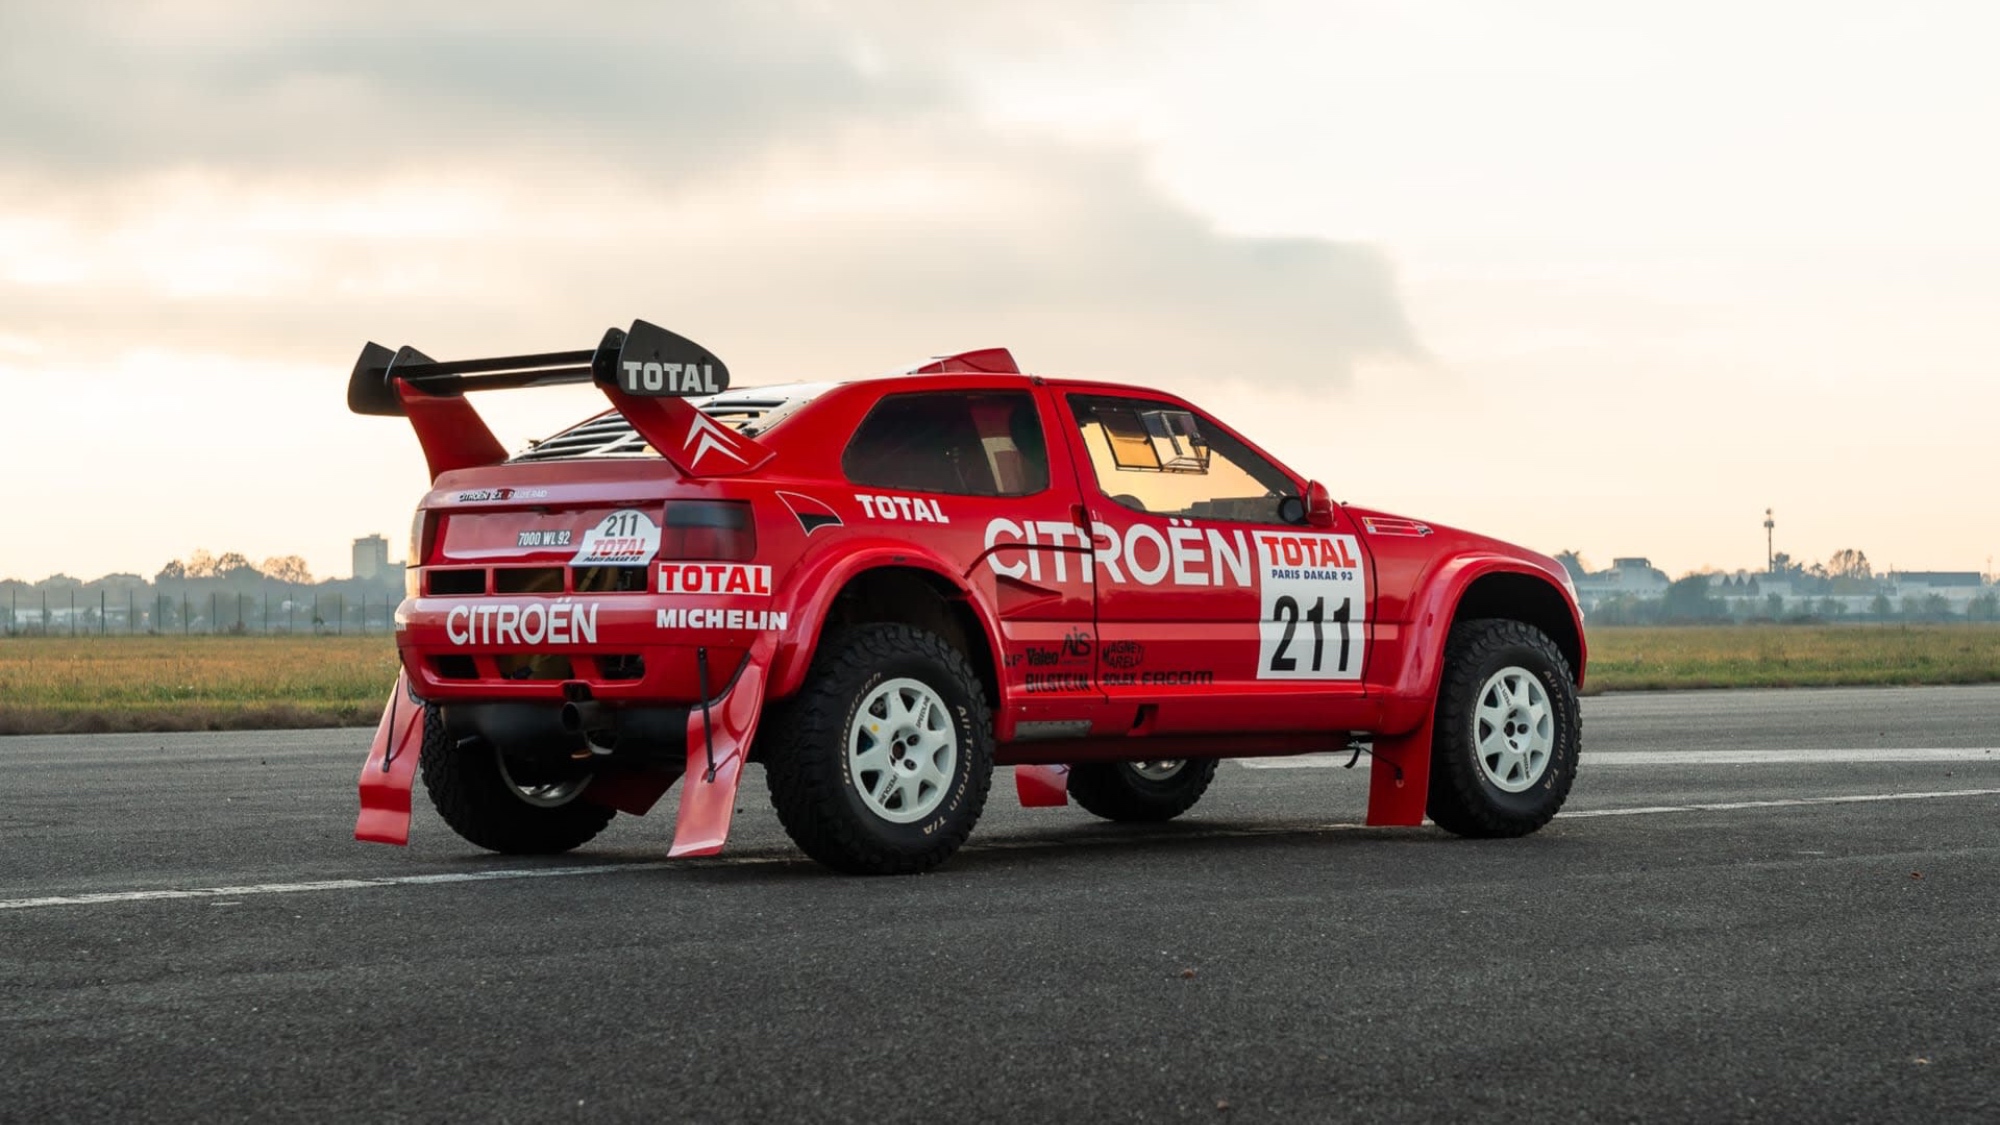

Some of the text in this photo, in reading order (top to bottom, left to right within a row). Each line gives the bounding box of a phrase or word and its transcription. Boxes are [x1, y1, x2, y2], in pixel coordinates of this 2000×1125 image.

[623, 361, 719, 393] TOTAL
[854, 494, 950, 523] TOTAL
[604, 513, 639, 537] 211
[518, 531, 571, 547] 7000 WL 92
[591, 538, 646, 557] TOTAL
[983, 517, 1252, 588] CITROËN
[1261, 536, 1357, 569] TOTAL
[661, 565, 769, 594] TOTAL
[1272, 569, 1353, 581] PARIS DAKAR 93
[446, 597, 599, 645] CITROËN
[656, 609, 787, 631] MICHELIN
[1270, 595, 1351, 672] 211
[1026, 647, 1059, 666] Valeo
[1025, 673, 1091, 694] BILSTEIN
[923, 815, 947, 835] T/A
